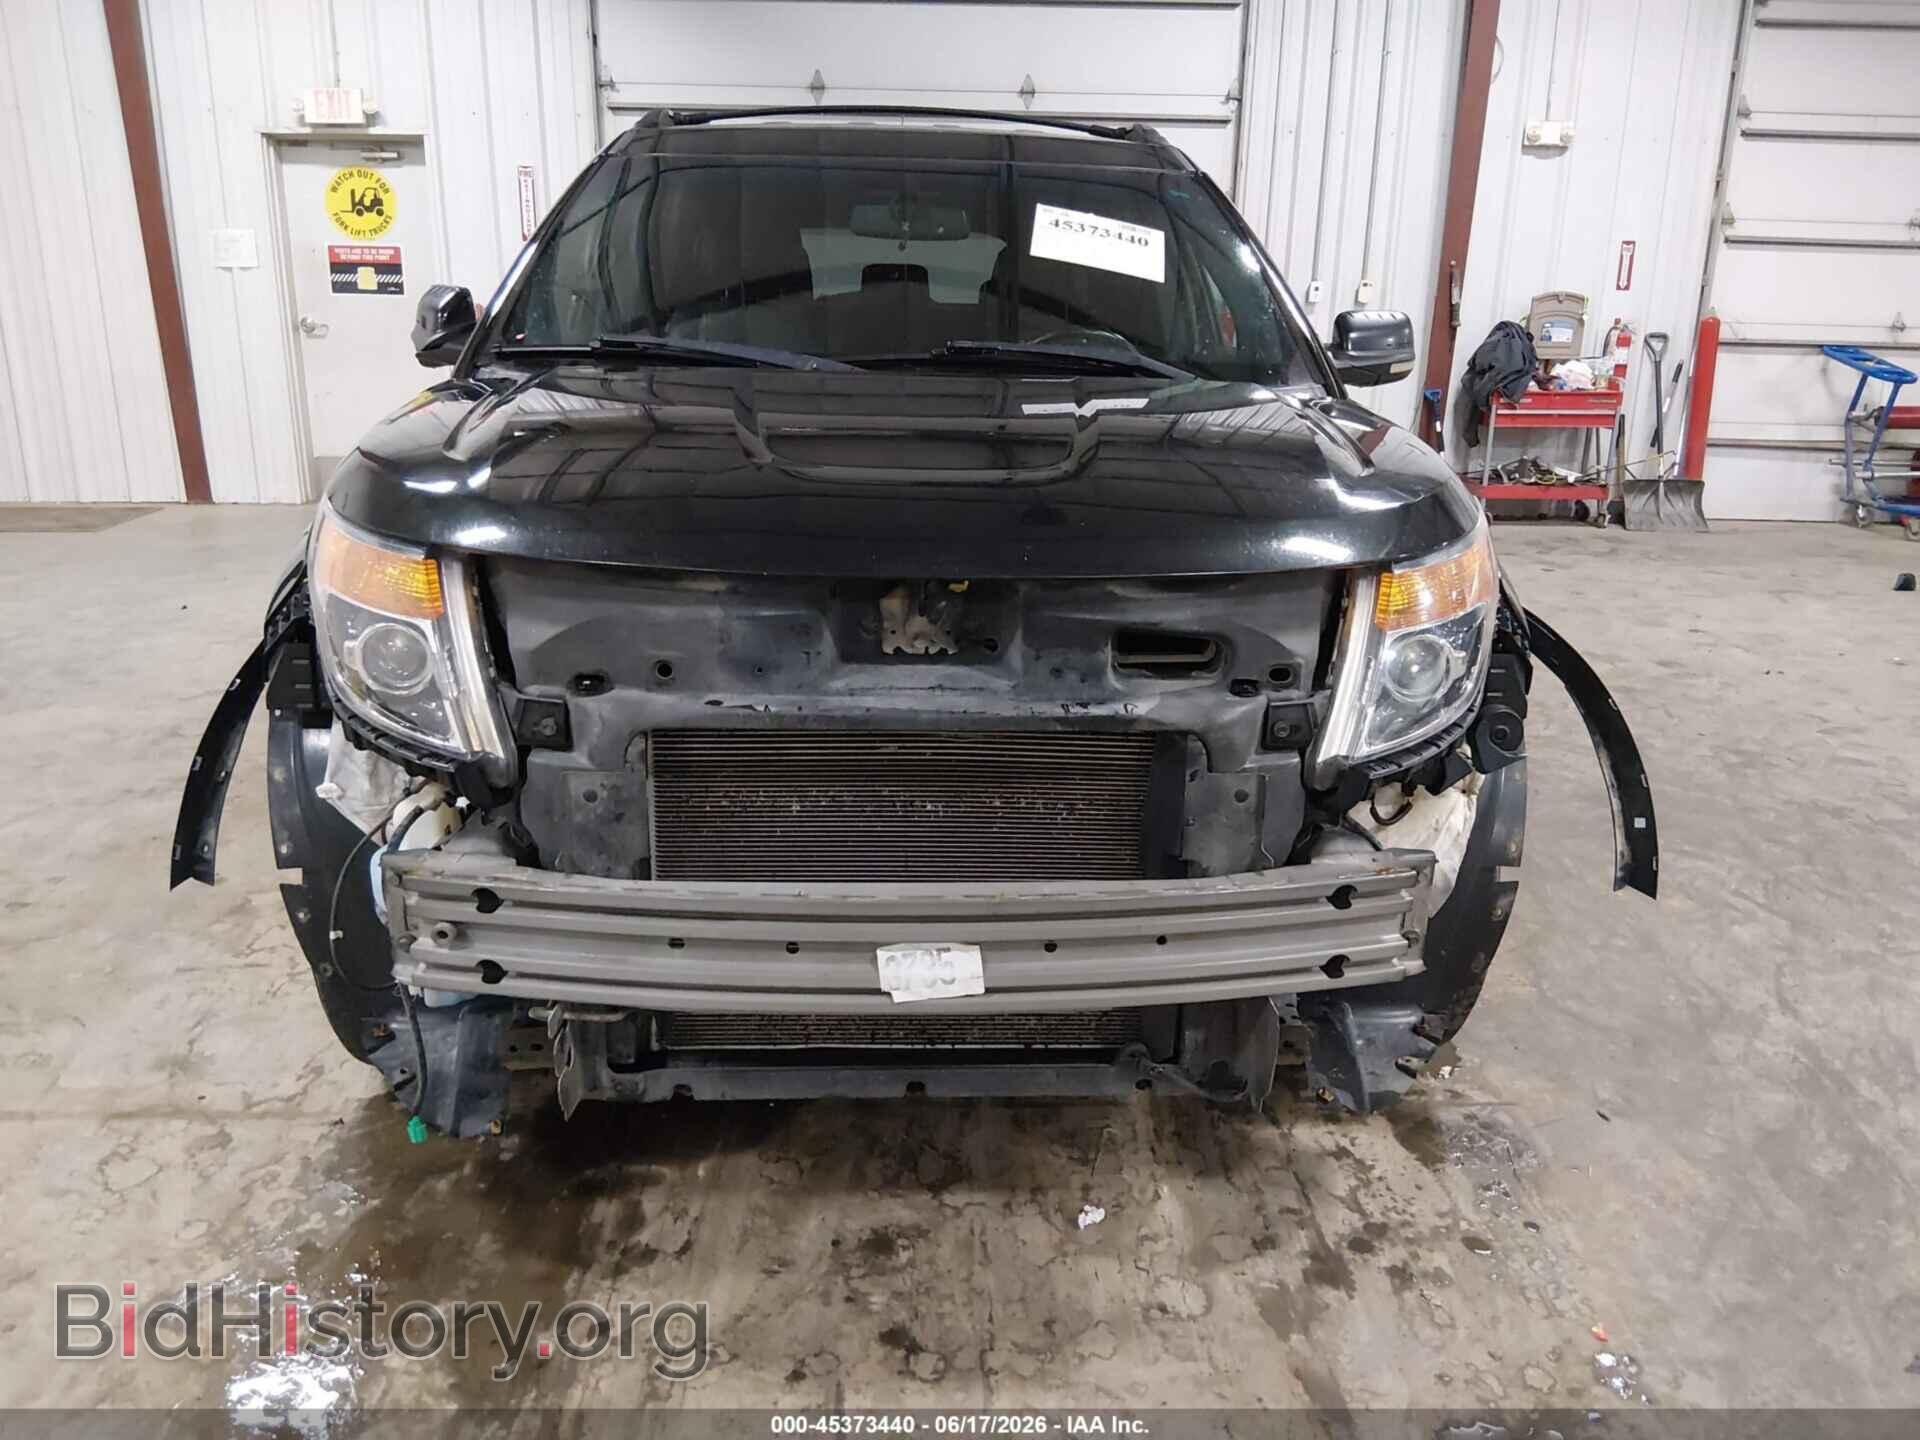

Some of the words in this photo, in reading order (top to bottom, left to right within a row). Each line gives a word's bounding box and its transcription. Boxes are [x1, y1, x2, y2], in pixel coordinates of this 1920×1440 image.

[313, 89, 352, 120] EXIT
[330, 169, 355, 193] WATCH
[356, 168, 375, 181] OUT
[375, 177, 391, 195] FOR
[332, 211, 350, 231] FORK
[350, 227, 366, 238] LIFT
[368, 214, 393, 237] TRUCKS
[1048, 218, 1149, 247] 45373440
